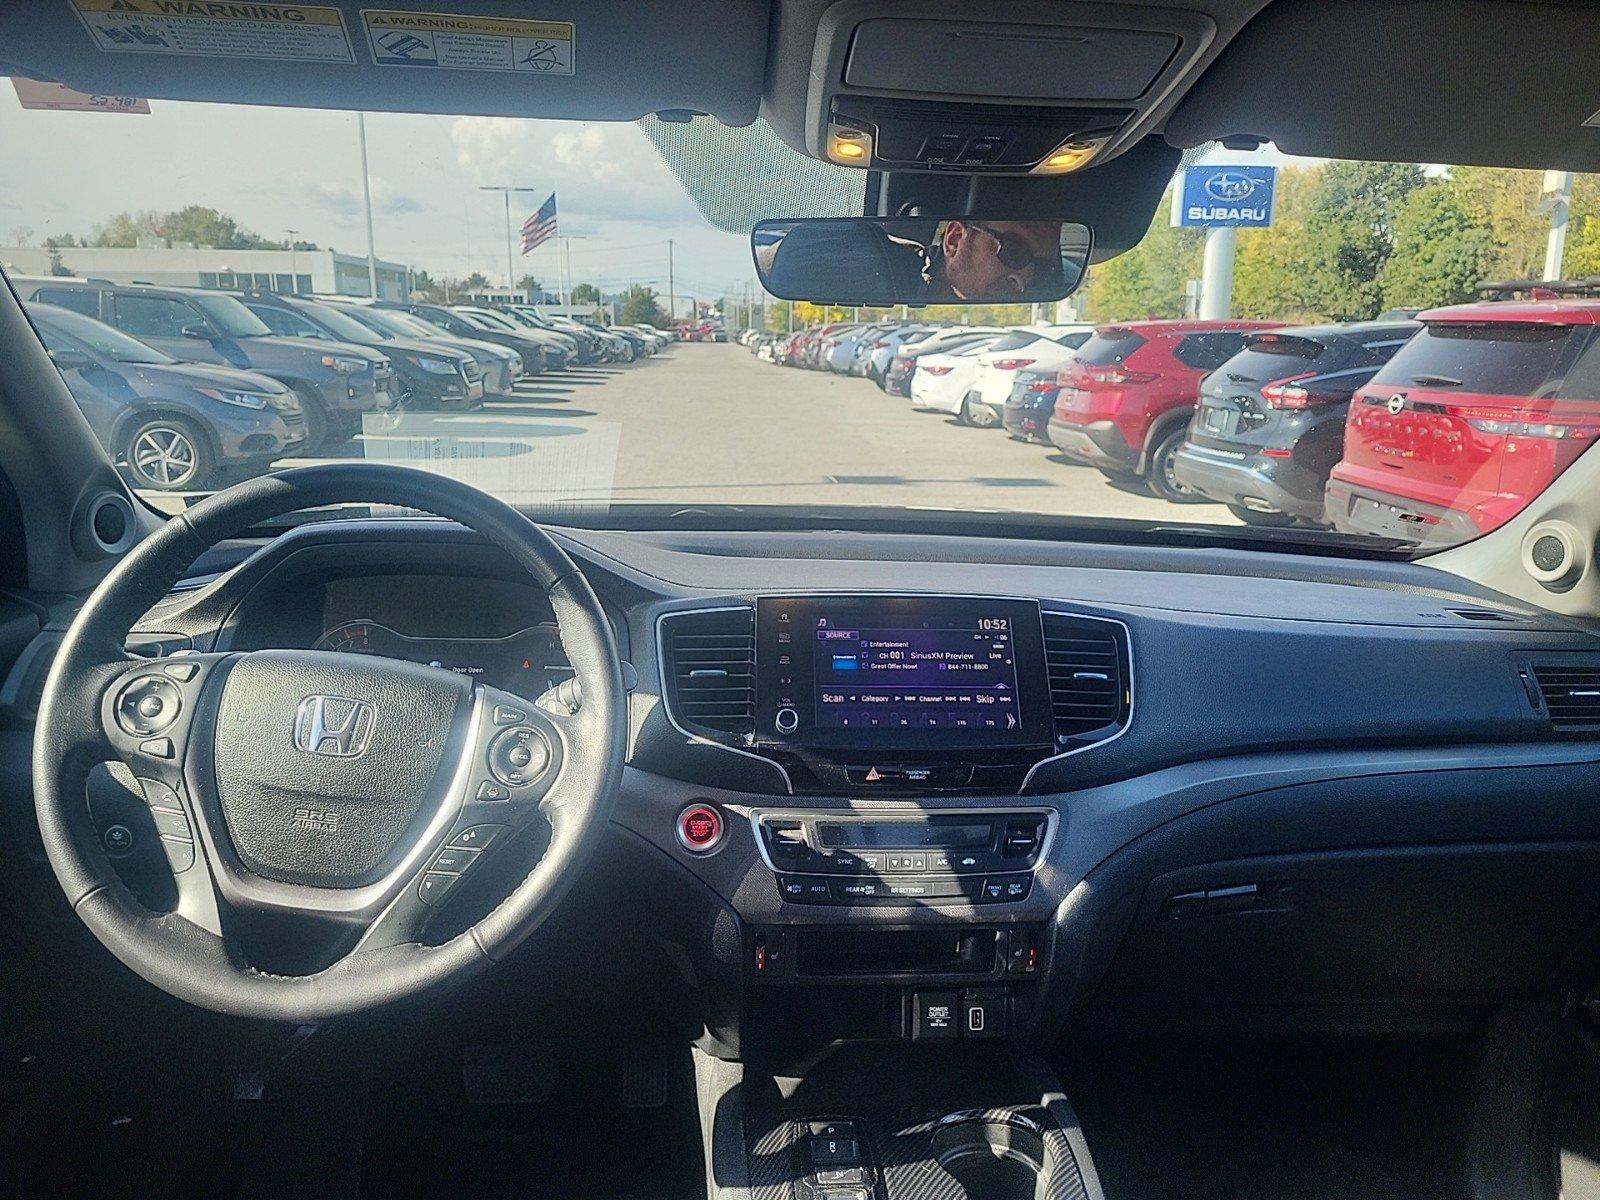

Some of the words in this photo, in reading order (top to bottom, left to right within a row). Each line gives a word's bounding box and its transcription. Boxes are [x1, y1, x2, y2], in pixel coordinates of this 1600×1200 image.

[153, 0, 305, 22] WARNING
[283, 25, 320, 33] BAGS
[1188, 207, 1265, 220] SUBARU
[977, 618, 1008, 630] 10:52
[825, 631, 851, 639] SOURCE
[890, 651, 905, 660] 001
[910, 651, 944, 660] SiriusXM
[945, 652, 974, 661] Preview
[467, 666, 484, 674] Open
[822, 693, 844, 703] Scan
[861, 694, 889, 704] Category
[919, 694, 942, 702] Channel
[976, 693, 995, 704] Skip
[294, 809, 338, 822] SRS
[292, 819, 338, 831] AIRBAG
[936, 858, 948, 866] A/C
[829, 1141, 836, 1150] R
